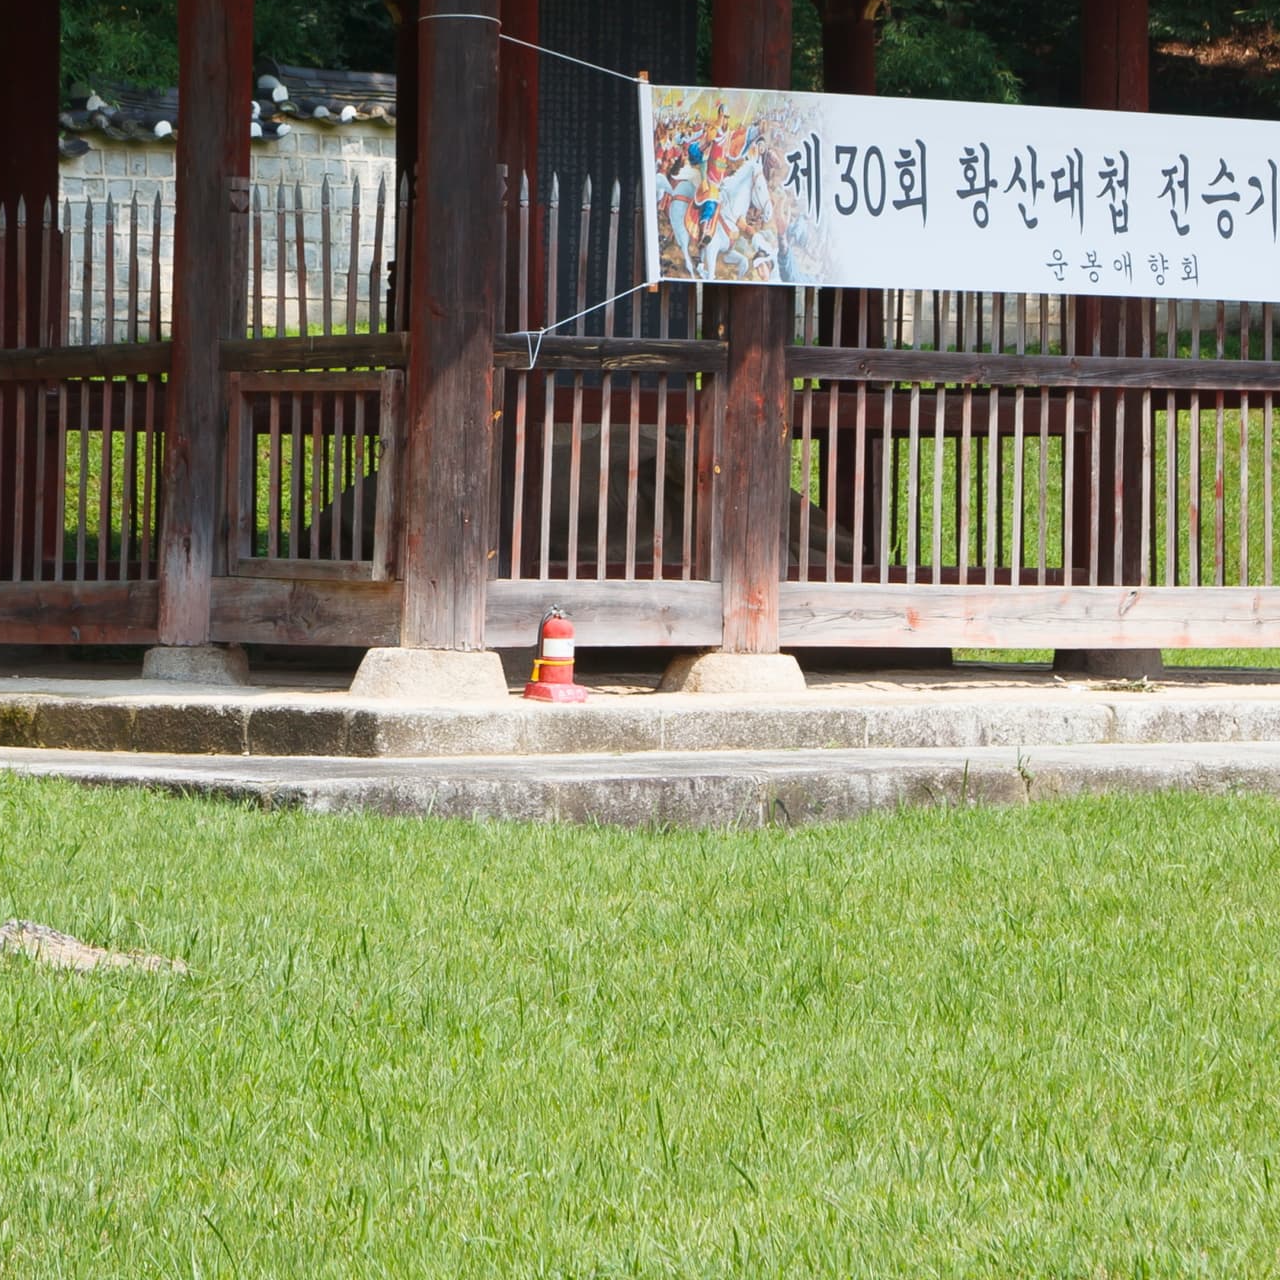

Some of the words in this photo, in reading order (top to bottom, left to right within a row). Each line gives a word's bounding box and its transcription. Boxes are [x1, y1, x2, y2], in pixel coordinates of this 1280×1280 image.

[783, 132, 927, 229] 제30회
[955, 141, 1130, 235] 황산대첩
[1045, 248, 1200, 288] 운봉애향회
